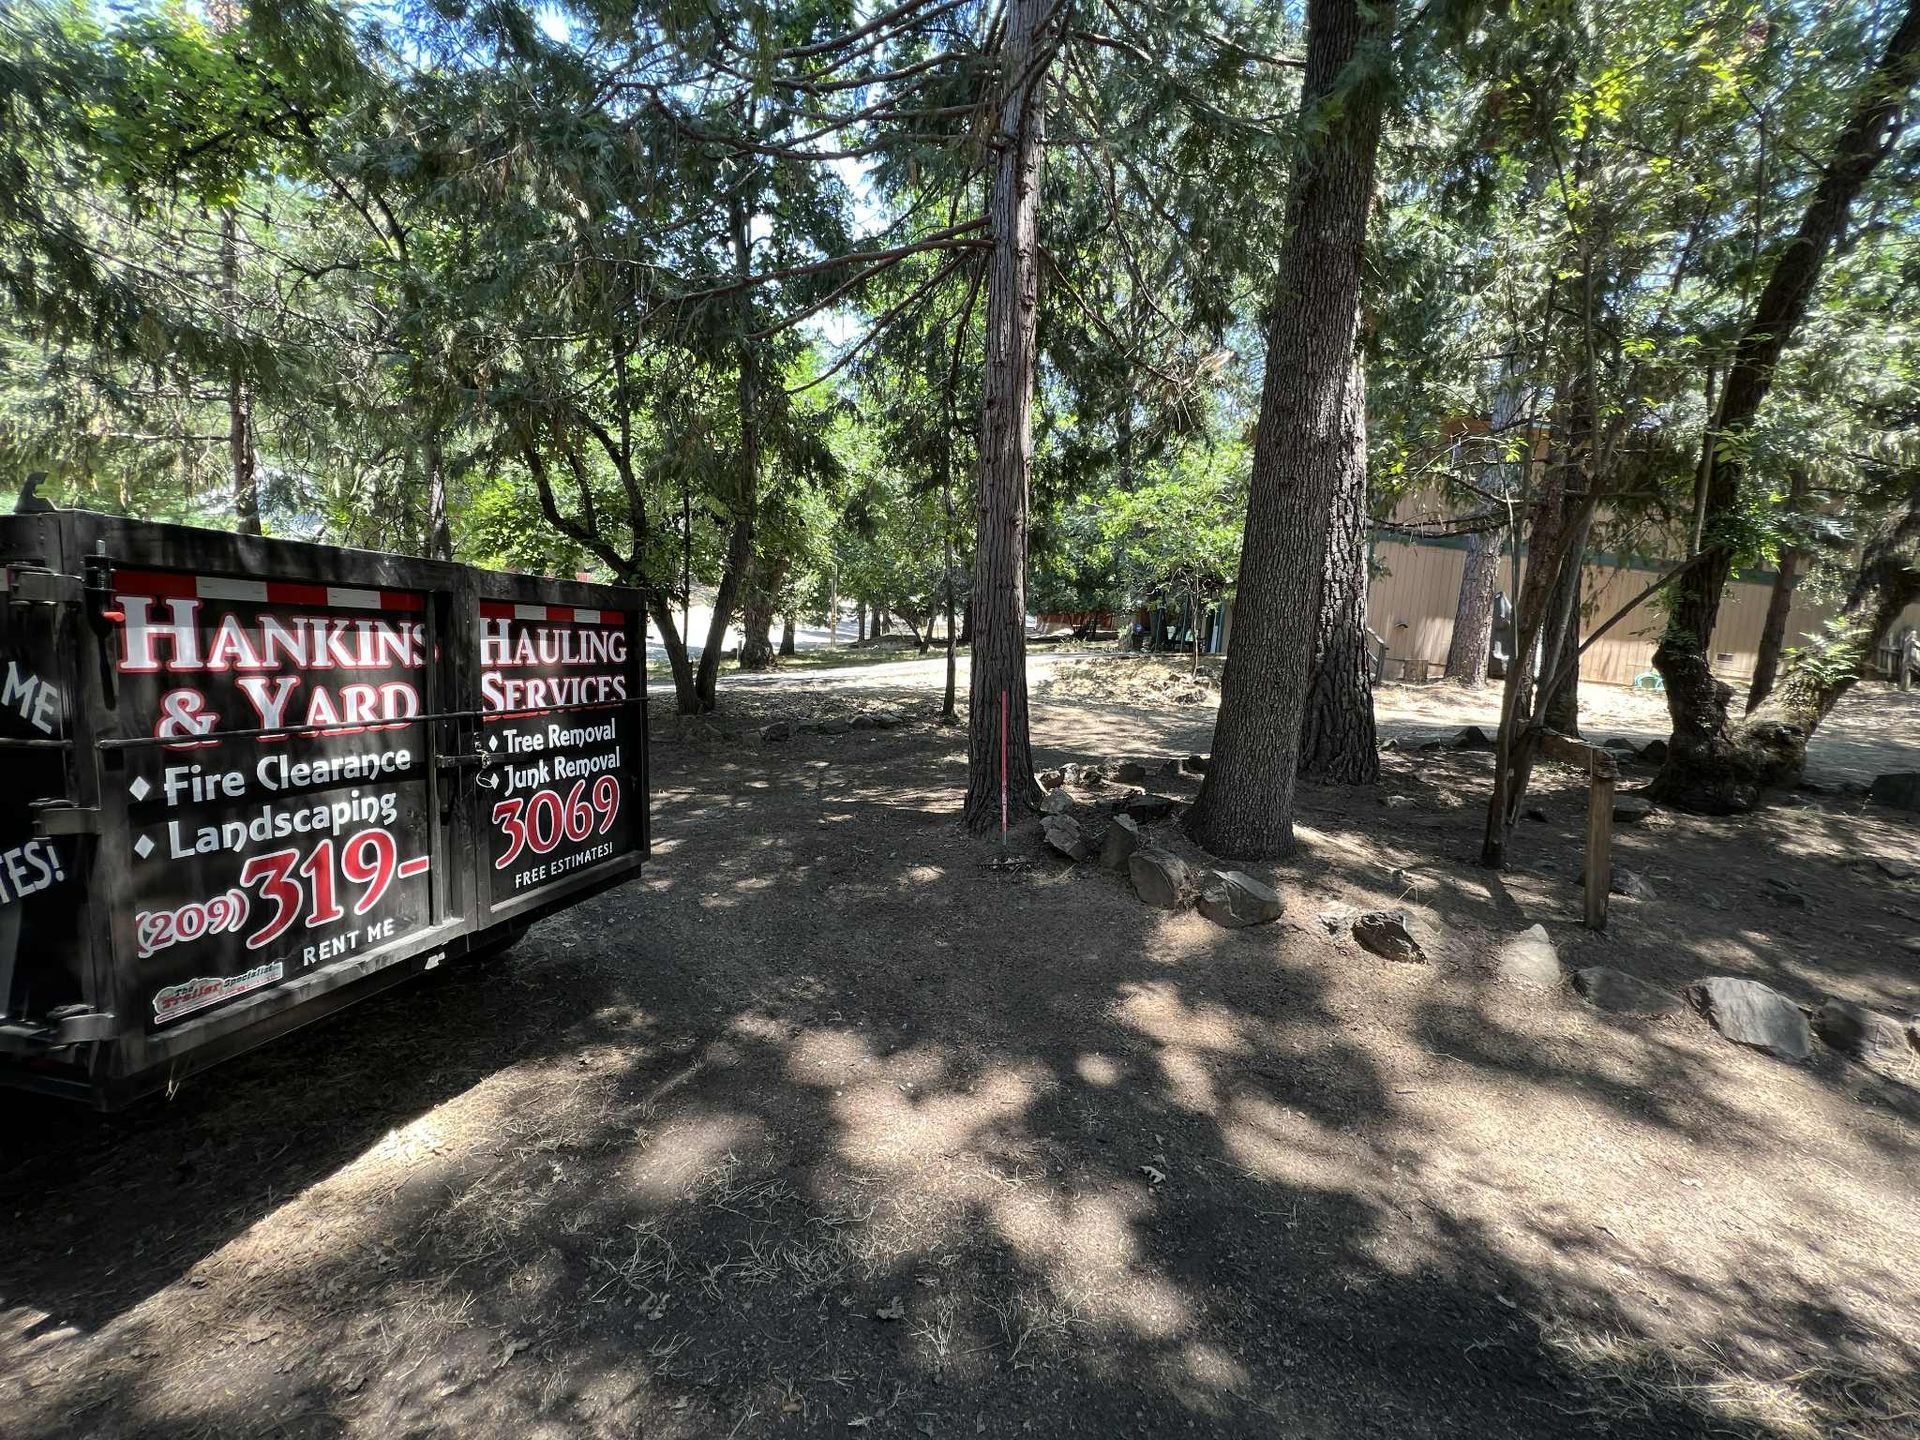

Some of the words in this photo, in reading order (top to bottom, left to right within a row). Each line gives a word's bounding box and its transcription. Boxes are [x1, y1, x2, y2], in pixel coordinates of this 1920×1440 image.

[480, 617, 628, 668] HAULING
[1, 661, 58, 734] ME
[154, 687, 221, 749] &
[235, 675, 420, 743] YARD
[481, 671, 627, 720] SERVICES
[503, 728, 545, 754] Tree
[548, 717, 616, 749] Removal
[164, 764, 246, 806] Fire
[256, 749, 411, 791] Clearance
[504, 759, 550, 797] Junk
[554, 745, 621, 780] Removal
[168, 789, 398, 860] Landscaping
[135, 888, 250, 959] (209)
[239, 827, 429, 950] 319-
[491, 774, 621, 870] 3069
[515, 865, 547, 889] FREE
[550, 841, 614, 876] ESTIMATES!
[303, 930, 360, 967] RENT
[367, 917, 396, 943] ME
